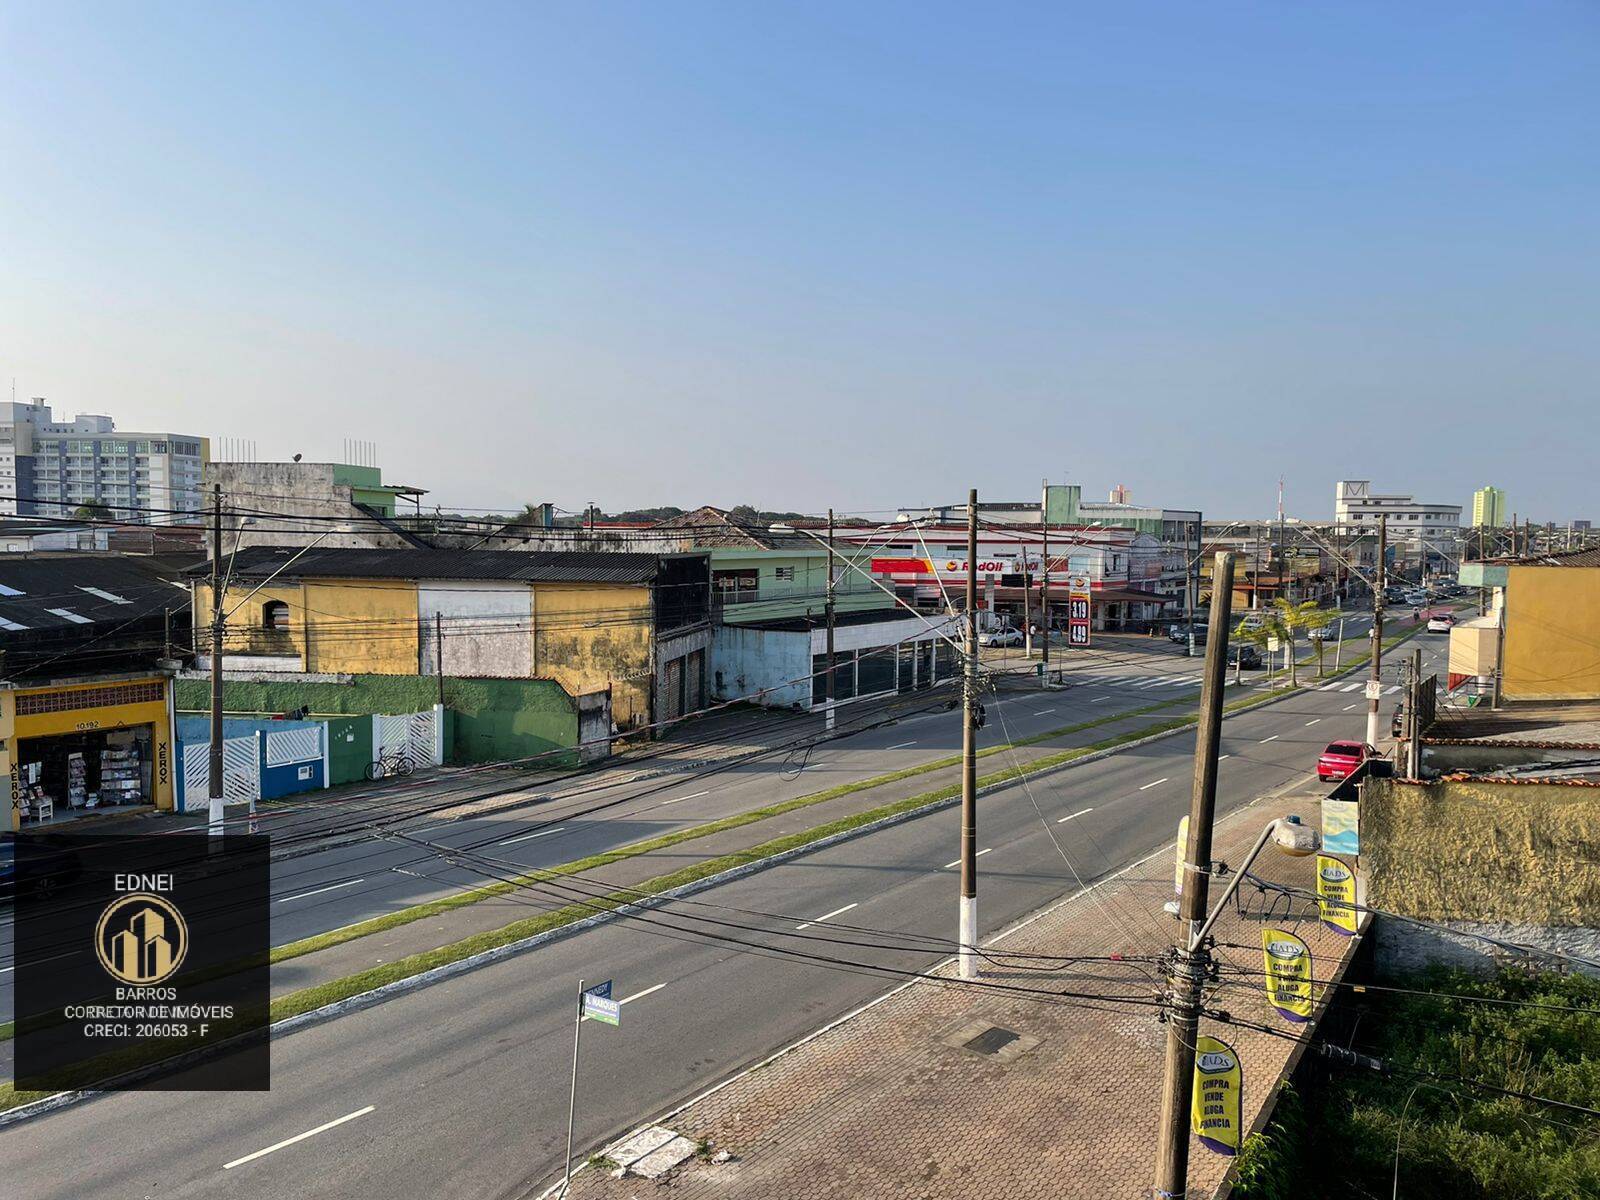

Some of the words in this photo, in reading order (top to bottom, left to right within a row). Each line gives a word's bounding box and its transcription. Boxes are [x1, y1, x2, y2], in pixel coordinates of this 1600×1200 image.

[159, 742, 168, 784] XEROX
[11, 763, 19, 810] XEROX
[1323, 885, 1349, 893] COMPRA
[1322, 910, 1350, 918] FINANCIA
[1273, 963, 1303, 972] COMPRA
[1277, 984, 1299, 992] ALUGA
[1202, 1079, 1230, 1090] COMPRA
[1204, 1092, 1224, 1102] VENDE
[1204, 1104, 1225, 1115] ALUGA
[1200, 1118, 1231, 1130] FINANCIA
